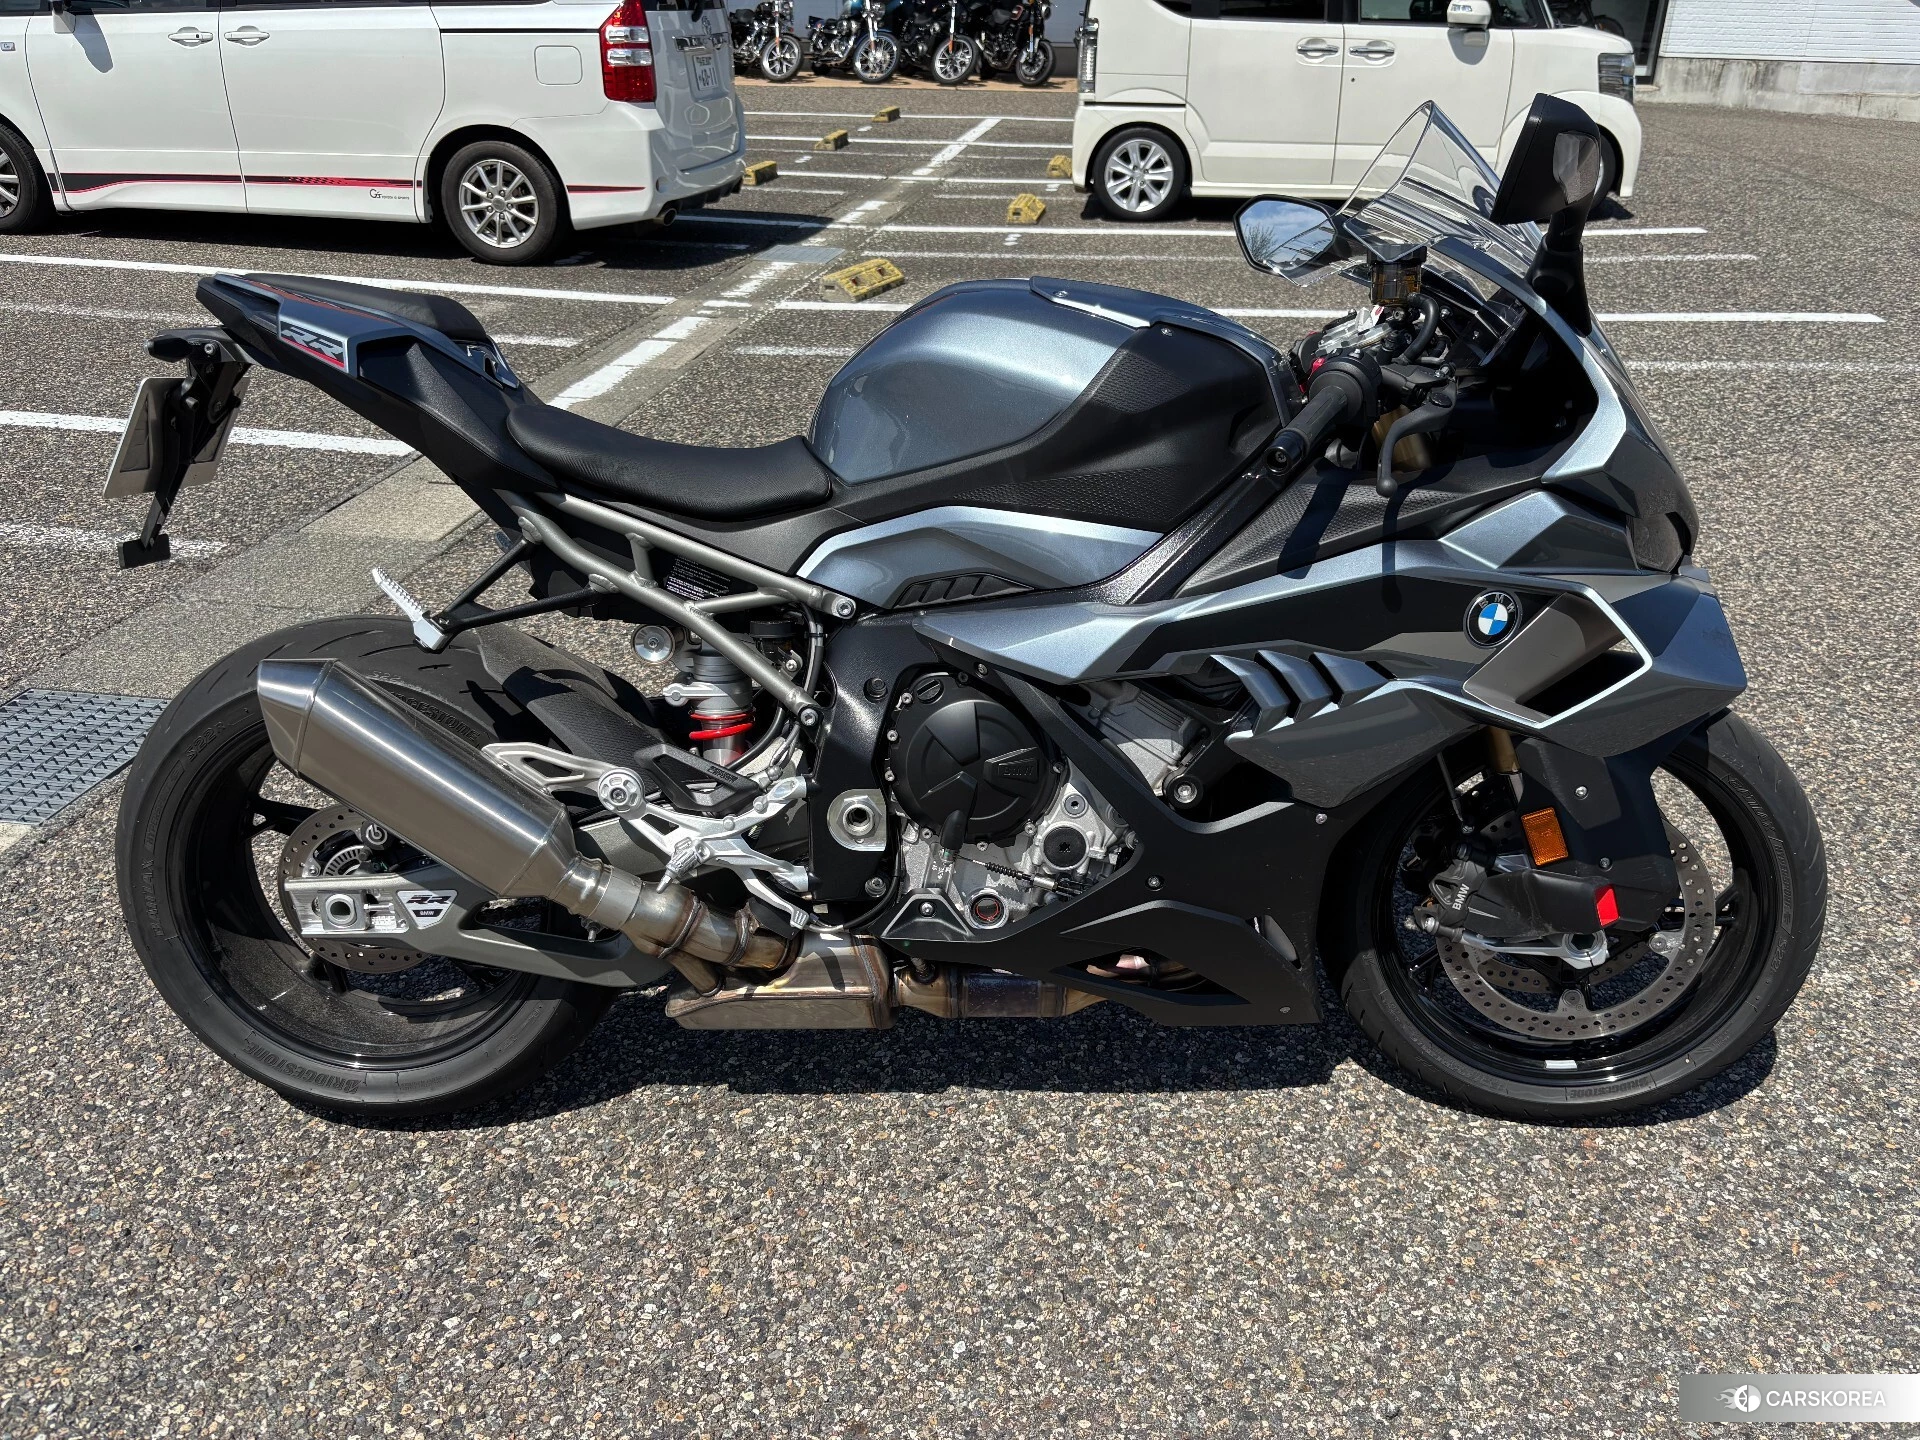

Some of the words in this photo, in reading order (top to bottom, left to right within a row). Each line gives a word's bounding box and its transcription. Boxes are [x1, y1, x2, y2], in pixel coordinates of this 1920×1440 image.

[281, 326, 344, 360] RR
[1478, 593, 1515, 614] BMW
[184, 731, 217, 763] S22
[406, 895, 452, 905] RR
[1452, 883, 1470, 911] BMW
[244, 1044, 362, 1095] BRIDGESTONE
[1570, 1076, 1651, 1100] BRIDGESTONE
